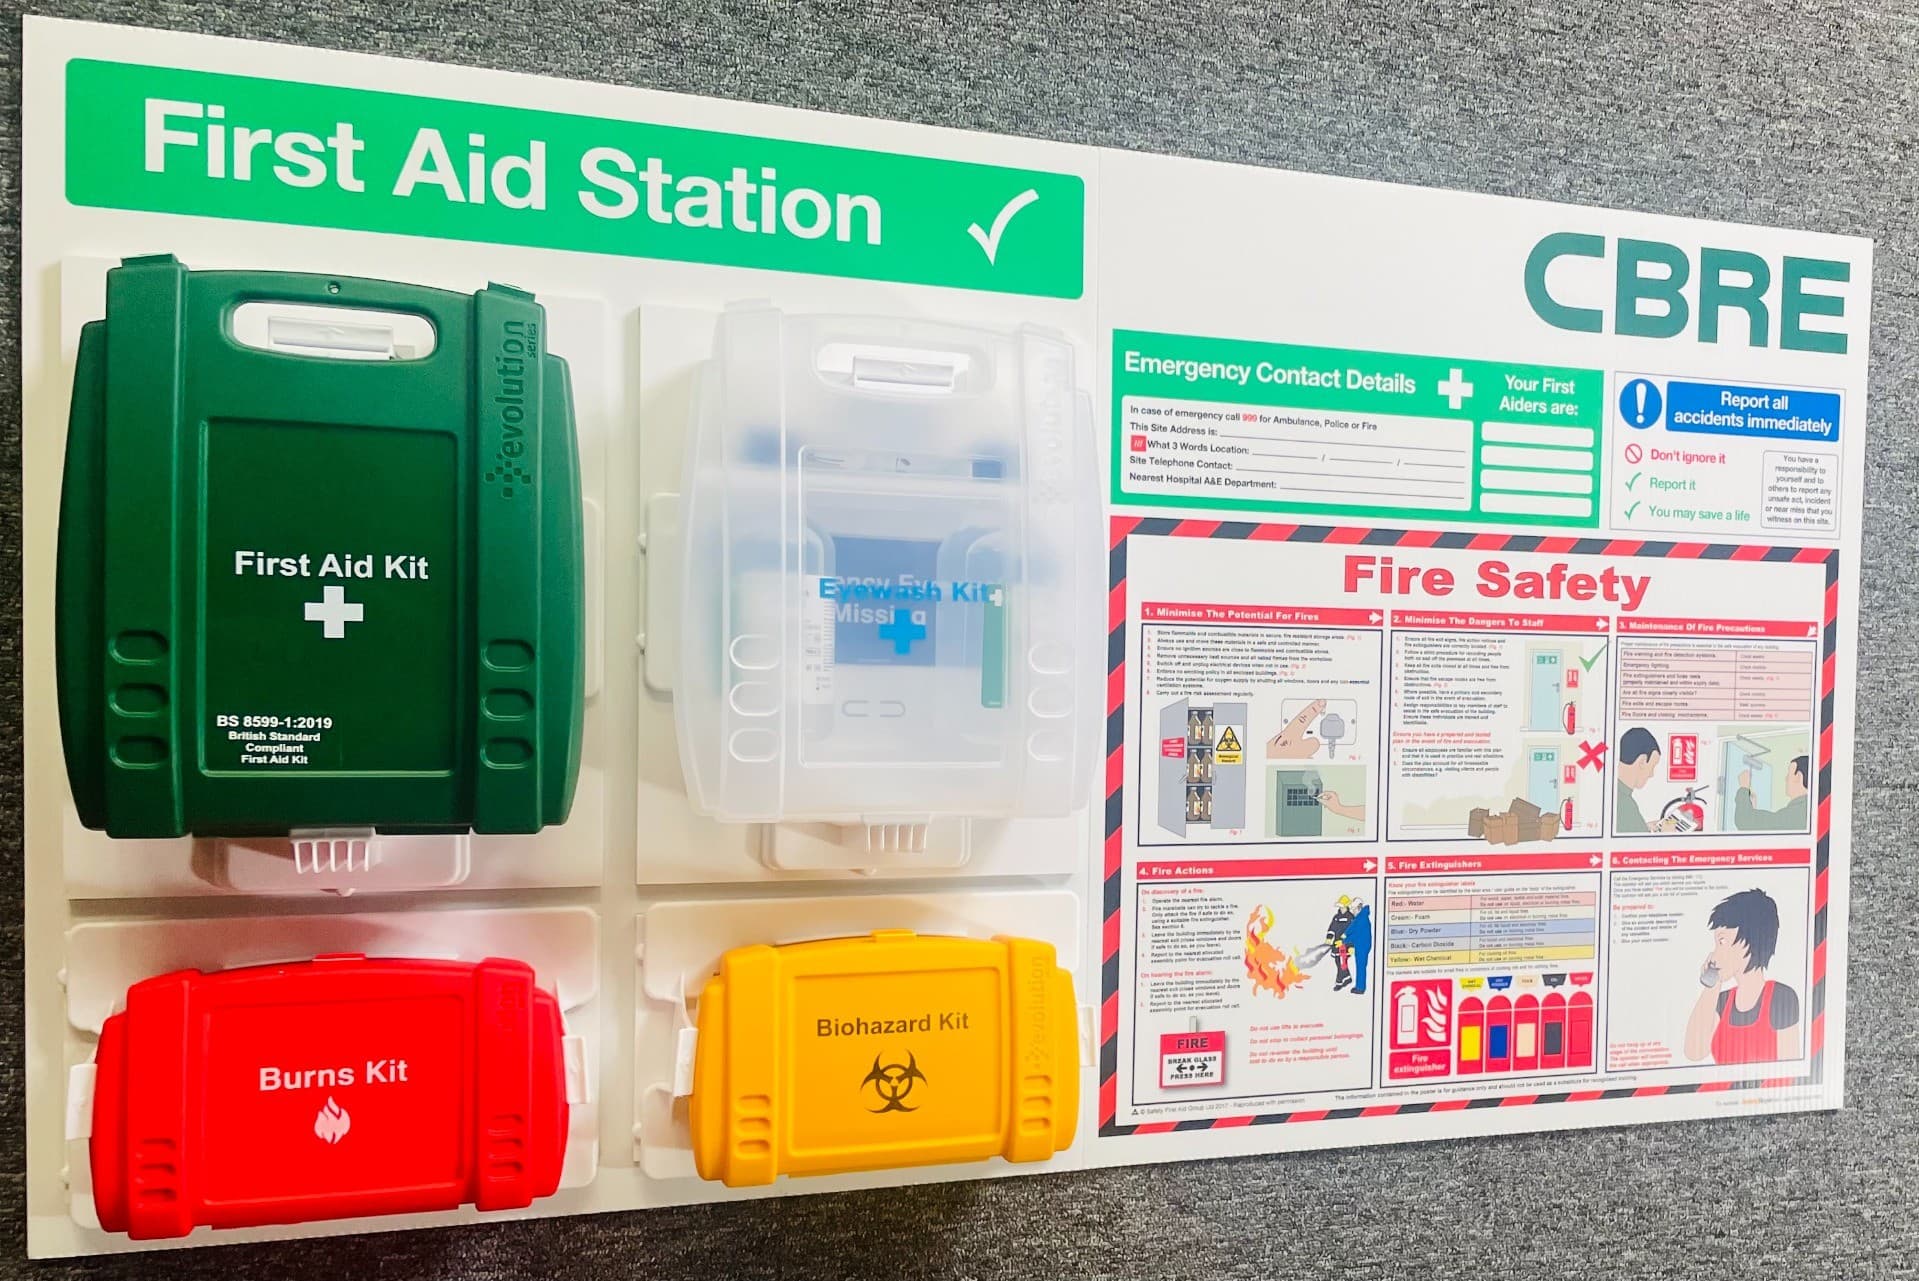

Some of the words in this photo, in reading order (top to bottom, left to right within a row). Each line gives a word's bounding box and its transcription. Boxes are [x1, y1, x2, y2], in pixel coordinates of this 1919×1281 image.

[143, 97, 365, 193] First
[392, 126, 546, 211] Aid
[577, 147, 882, 246] Station
[1524, 231, 1850, 355] CBRE
[523, 322, 537, 358] series
[1124, 350, 1251, 386] Emergency
[1256, 362, 1341, 389] Contact
[1346, 369, 1416, 394] Details
[495, 320, 524, 458] evolution
[1504, 374, 1539, 393] Your
[1542, 377, 1575, 395] First
[1499, 397, 1547, 414] Aiders
[1551, 399, 1578, 416] are:
[1720, 391, 1766, 411] Report
[1769, 395, 1788, 410] all
[1130, 405, 1139, 414] In
[1140, 406, 1162, 416] case
[1164, 407, 1174, 417] of
[1175, 410, 1223, 422] emergency
[1225, 410, 1240, 421] call
[1242, 413, 1257, 423] 999
[1259, 414, 1271, 424] for
[1273, 415, 1322, 428] Ambulance,
[1324, 418, 1349, 430] Police
[1351, 421, 1360, 430] or
[1361, 421, 1377, 431] Fire
[1674, 410, 1744, 428] accidents
[1747, 414, 1832, 436] immediately
[1130, 421, 1148, 432] This
[1151, 423, 1167, 434] Site
[1169, 424, 1205, 436] Address
[1207, 426, 1218, 436] is:
[1147, 439, 1169, 450] What
[1172, 440, 1178, 450] 3
[1180, 441, 1208, 452] Words
[1210, 443, 1249, 455] Location:
[1130, 455, 1146, 465] Site
[1148, 456, 1194, 469] Telephone
[1196, 459, 1233, 470] Contact:
[1650, 448, 1680, 463] Don't
[1682, 450, 1711, 466] ignore
[1714, 451, 1726, 464] it
[1797, 455, 1813, 463] have
[1775, 465, 1817, 475] responsibility
[1129, 471, 1164, 482] Nearest
[1166, 473, 1202, 486] Hospital
[1204, 476, 1222, 486] A&E
[1225, 477, 1277, 490] Department:
[1649, 477, 1687, 494] Report
[1689, 478, 1696, 491] it
[1803, 476, 1815, 484] and
[1819, 488, 1832, 496] any
[1649, 505, 1668, 519] You
[1670, 508, 1695, 523] may
[1698, 510, 1722, 521] save
[1725, 511, 1732, 521] a
[1734, 508, 1750, 522] life
[1803, 516, 1815, 524] this
[234, 550, 310, 577] First
[318, 553, 373, 579] Aid
[385, 555, 428, 580] Kit
[819, 577, 941, 603] Eyewash
[952, 581, 990, 603] Kit
[1343, 555, 1454, 596] Fire
[1475, 560, 1651, 611] Safety
[1144, 608, 1153, 617] 1.
[1156, 608, 1203, 617] Minimise
[1206, 609, 1224, 619] The
[1228, 610, 1272, 619] Potential
[1275, 611, 1292, 620] For
[1294, 612, 1319, 621] Fires
[1393, 615, 1402, 623] 2.
[1404, 615, 1447, 625] Minimise
[1450, 616, 1466, 625] The
[1468, 617, 1505, 627] Dangers
[1508, 618, 1520, 626] To
[1522, 618, 1544, 627] Staff
[1619, 621, 1627, 629] 3.
[1629, 621, 1683, 631] Maintenance
[1686, 622, 1696, 631] Of
[1698, 623, 1714, 632] Fire
[1716, 624, 1765, 633] Precautions
[216, 714, 239, 727] BS
[243, 716, 332, 729] 8599-1:2019
[228, 730, 266, 740] British
[268, 731, 320, 742] Standard
[245, 742, 304, 754] Compliant
[240, 754, 268, 764] First
[270, 755, 290, 764] Aid
[291, 755, 308, 764] Kit
[1387, 861, 1396, 870] 5.
[1399, 860, 1417, 869] Fire
[1419, 860, 1482, 870] Extinguishers
[1612, 856, 1620, 864] 6.
[1622, 855, 1669, 865] Contacting
[1671, 855, 1687, 863] The
[1689, 854, 1735, 864] Emergency
[1737, 853, 1773, 862] Services
[1138, 867, 1149, 876] 4.
[1151, 866, 1172, 875] Fire
[1174, 865, 1213, 875] Actions
[816, 1013, 931, 1037] Biohazard
[938, 1011, 969, 1031] Kit
[1177, 1037, 1208, 1049] FIRE
[1411, 1054, 1429, 1063] Fire
[258, 1066, 355, 1091] Burns
[365, 1058, 408, 1084] Kit
[1393, 1062, 1446, 1074] extinguisher
